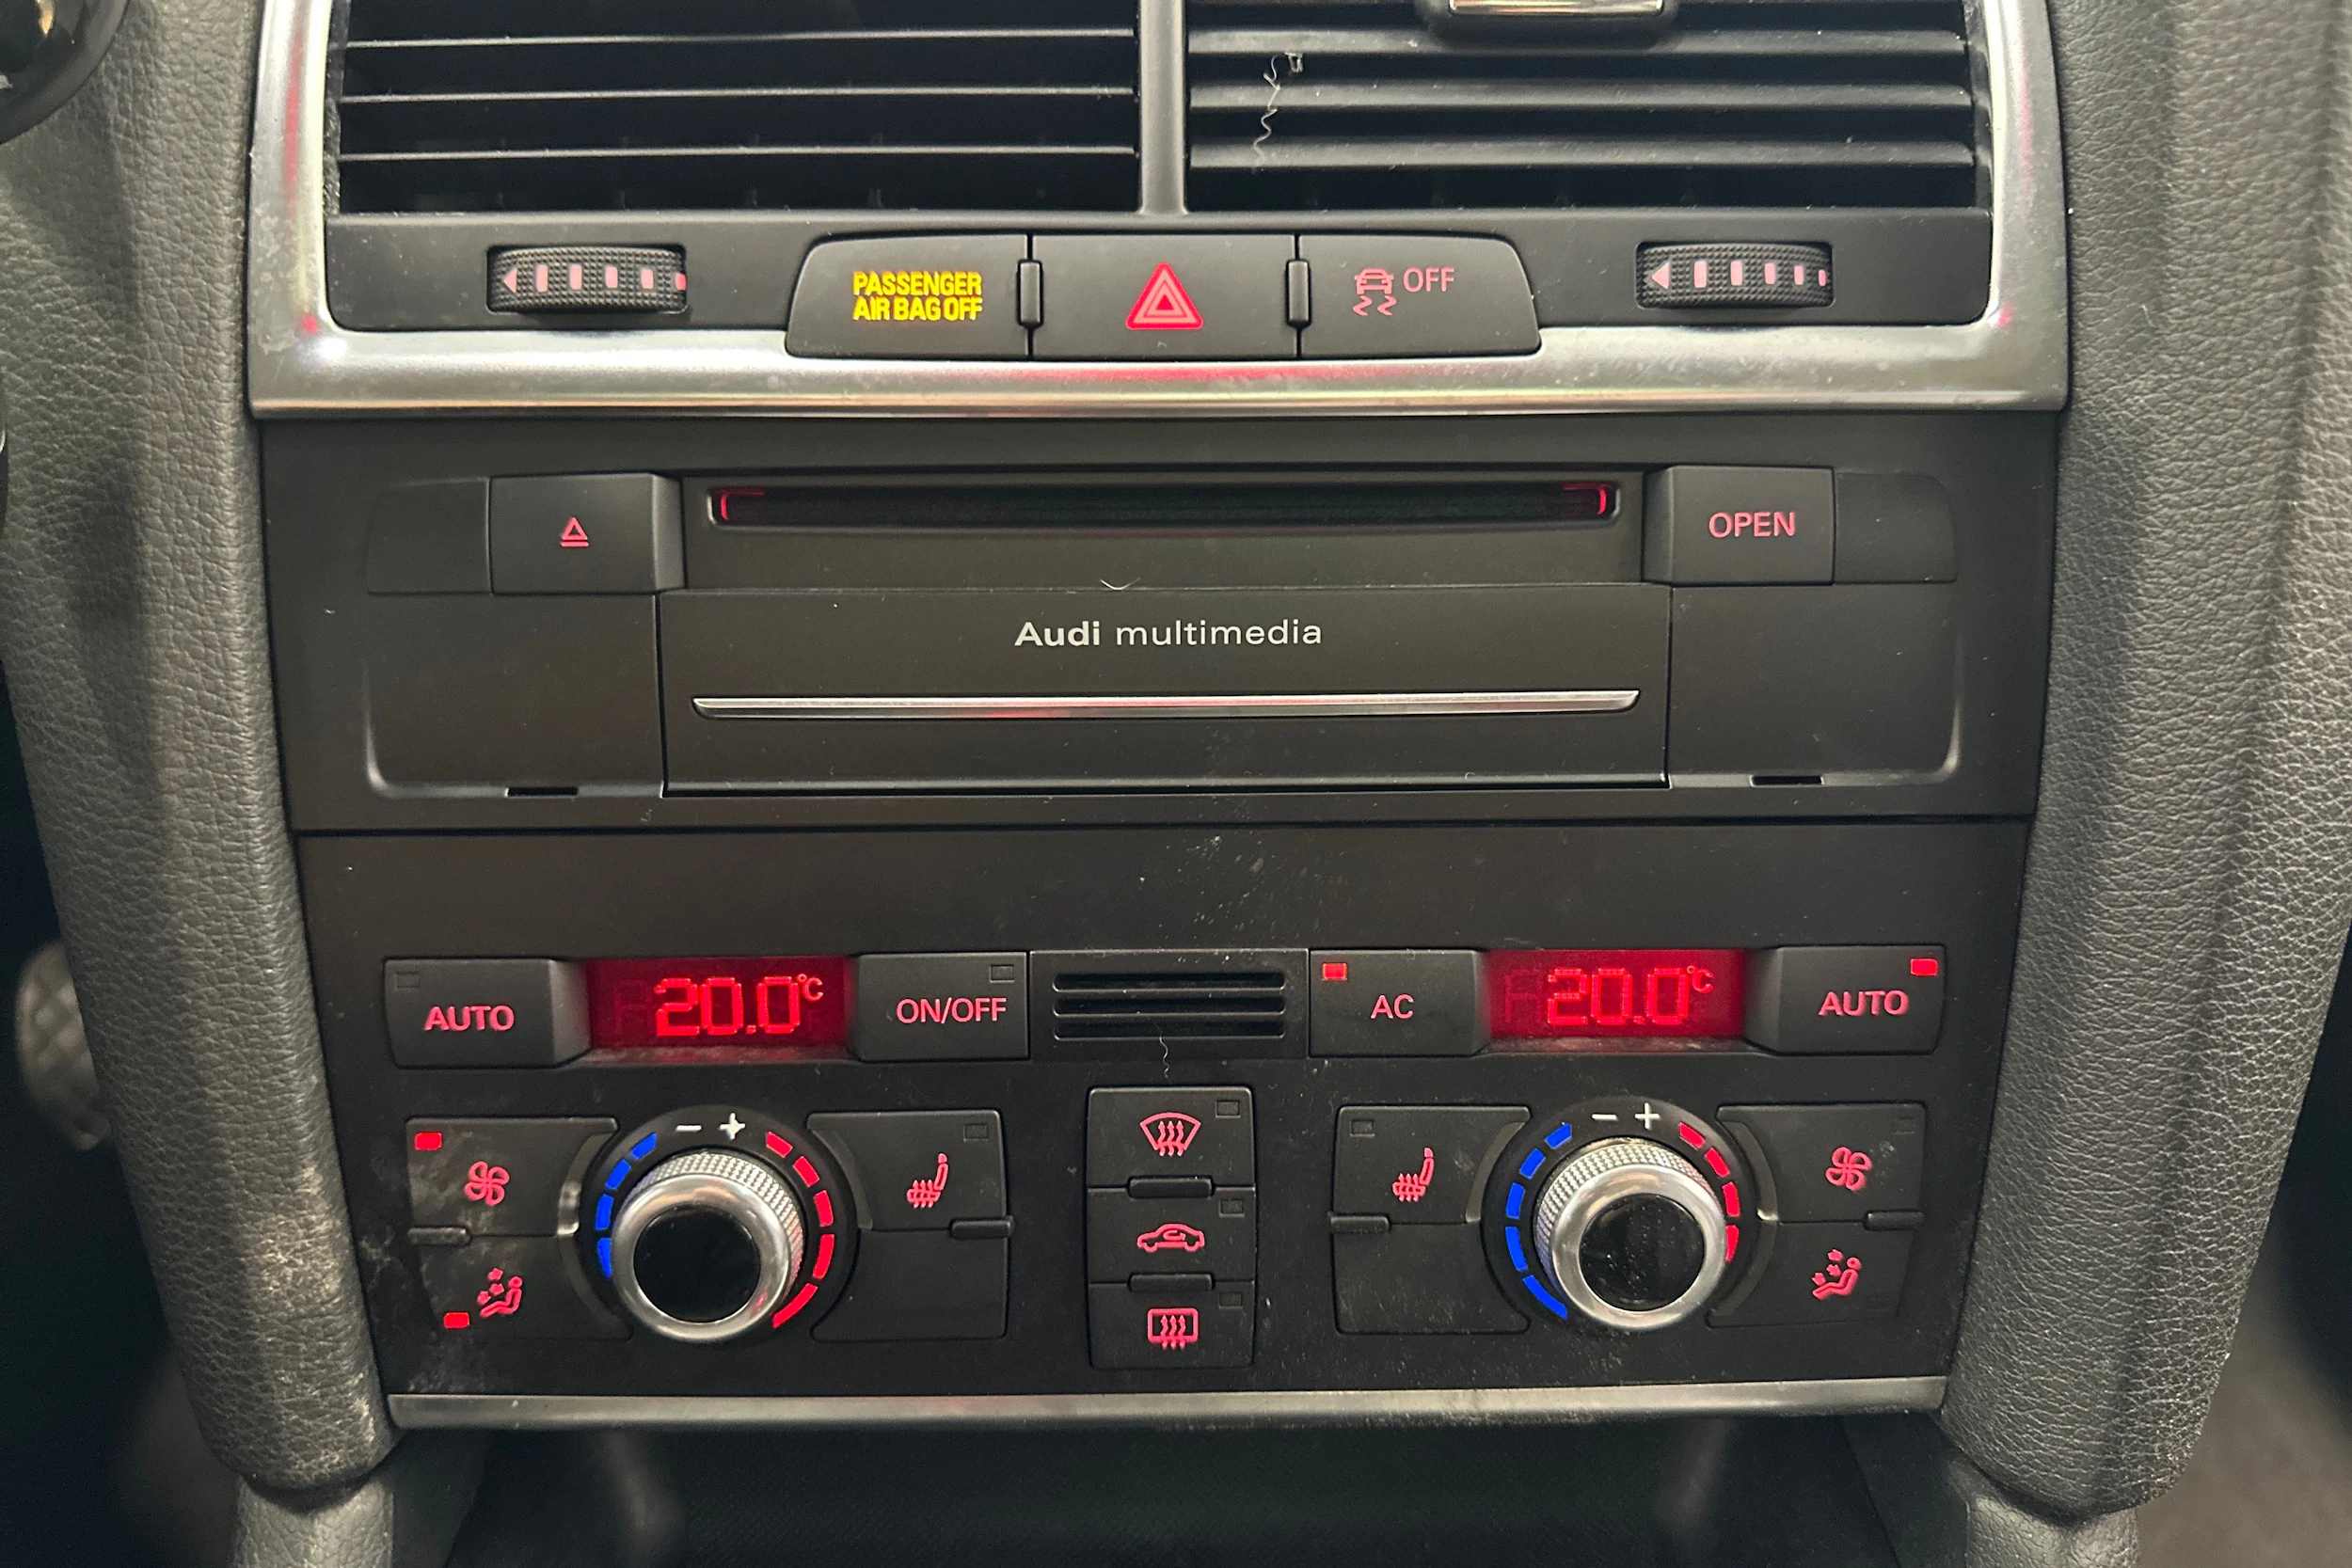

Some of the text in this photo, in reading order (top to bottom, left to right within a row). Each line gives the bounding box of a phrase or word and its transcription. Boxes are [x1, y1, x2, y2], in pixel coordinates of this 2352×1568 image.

[852, 270, 982, 296] PASSENGER
[1403, 266, 1454, 293] OFF
[852, 295, 983, 321] AIR BAG OFF
[1708, 511, 1796, 538] OPEN
[1014, 618, 1323, 647] Audi multimedia
[896, 996, 1007, 1024] ON/OFF
[1371, 993, 1414, 1021] AC
[1819, 989, 1910, 1017] AUTO
[423, 1004, 516, 1032] AUTO
